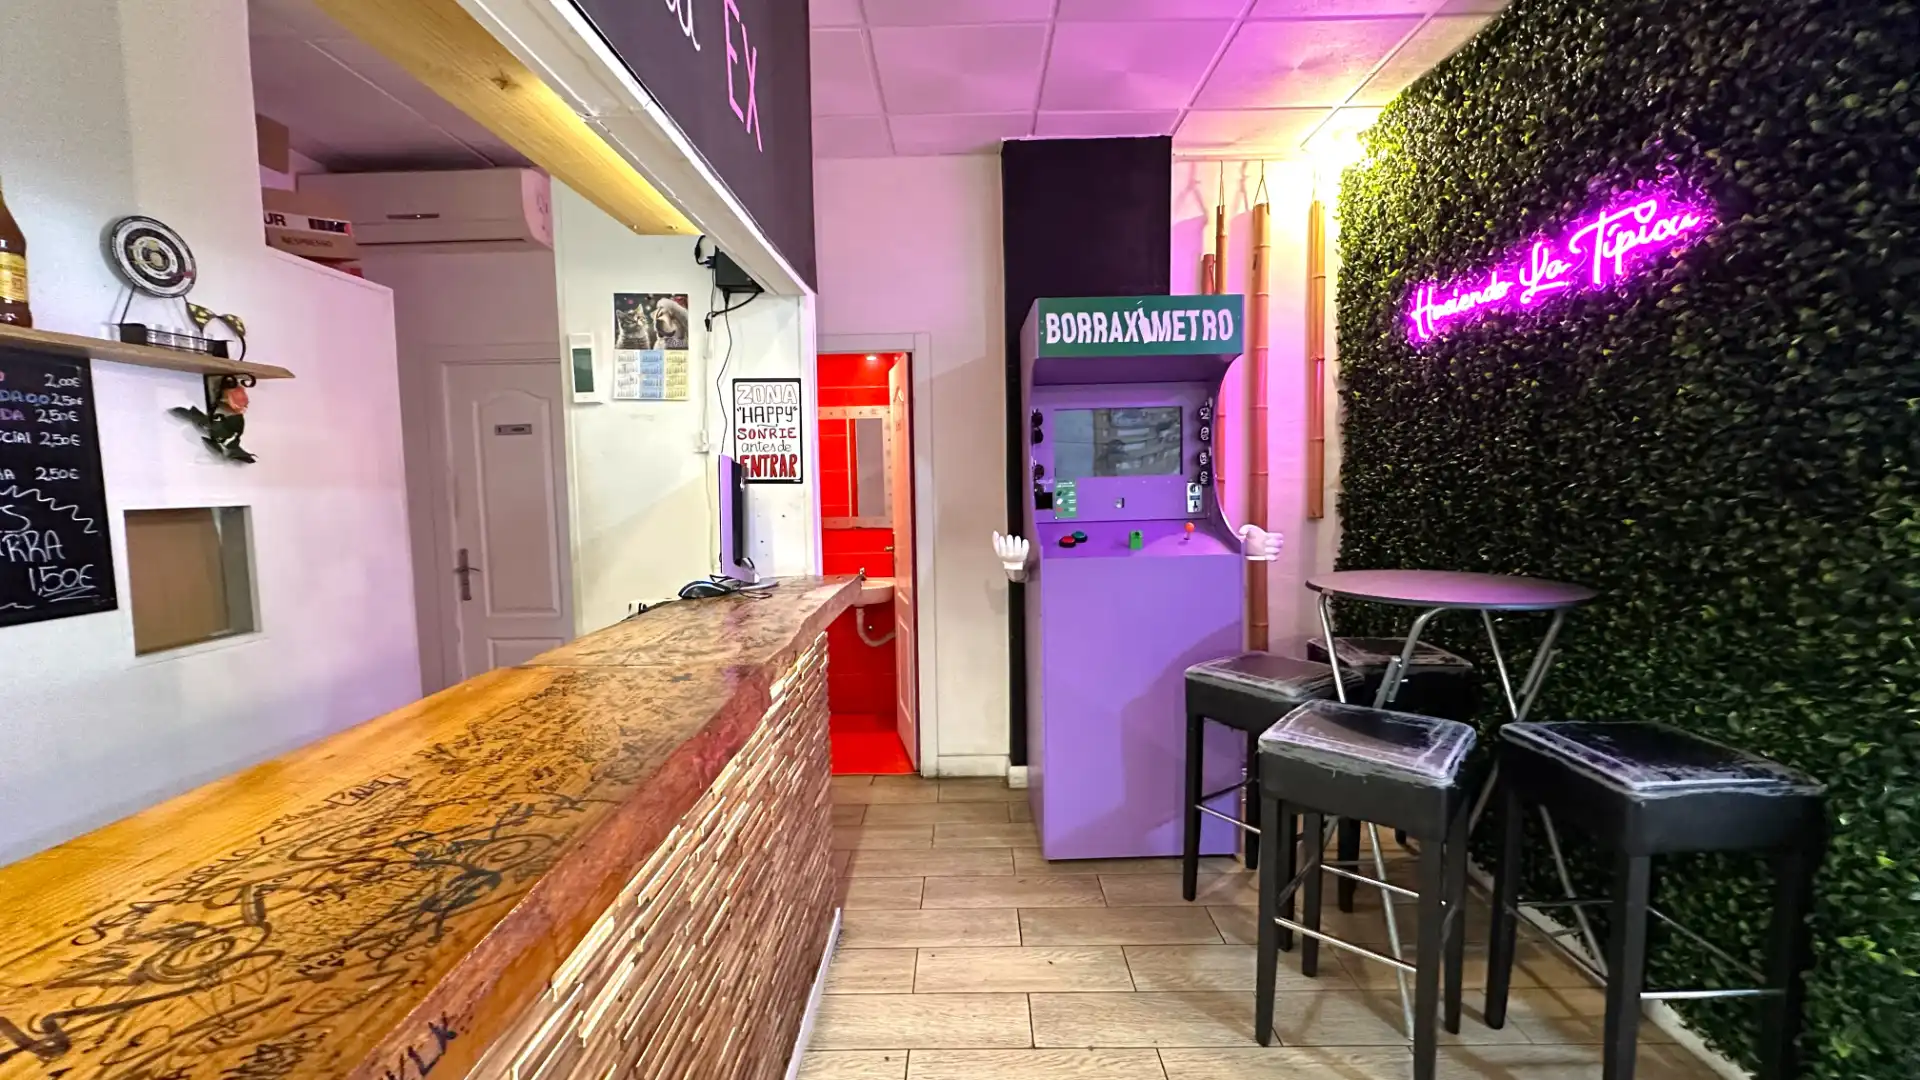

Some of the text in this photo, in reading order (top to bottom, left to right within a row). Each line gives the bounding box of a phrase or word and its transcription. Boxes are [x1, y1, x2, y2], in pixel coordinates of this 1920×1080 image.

[1519, 241, 1572, 305] La
[736, 384, 798, 405] ZONA
[741, 439, 793, 453] antes de
